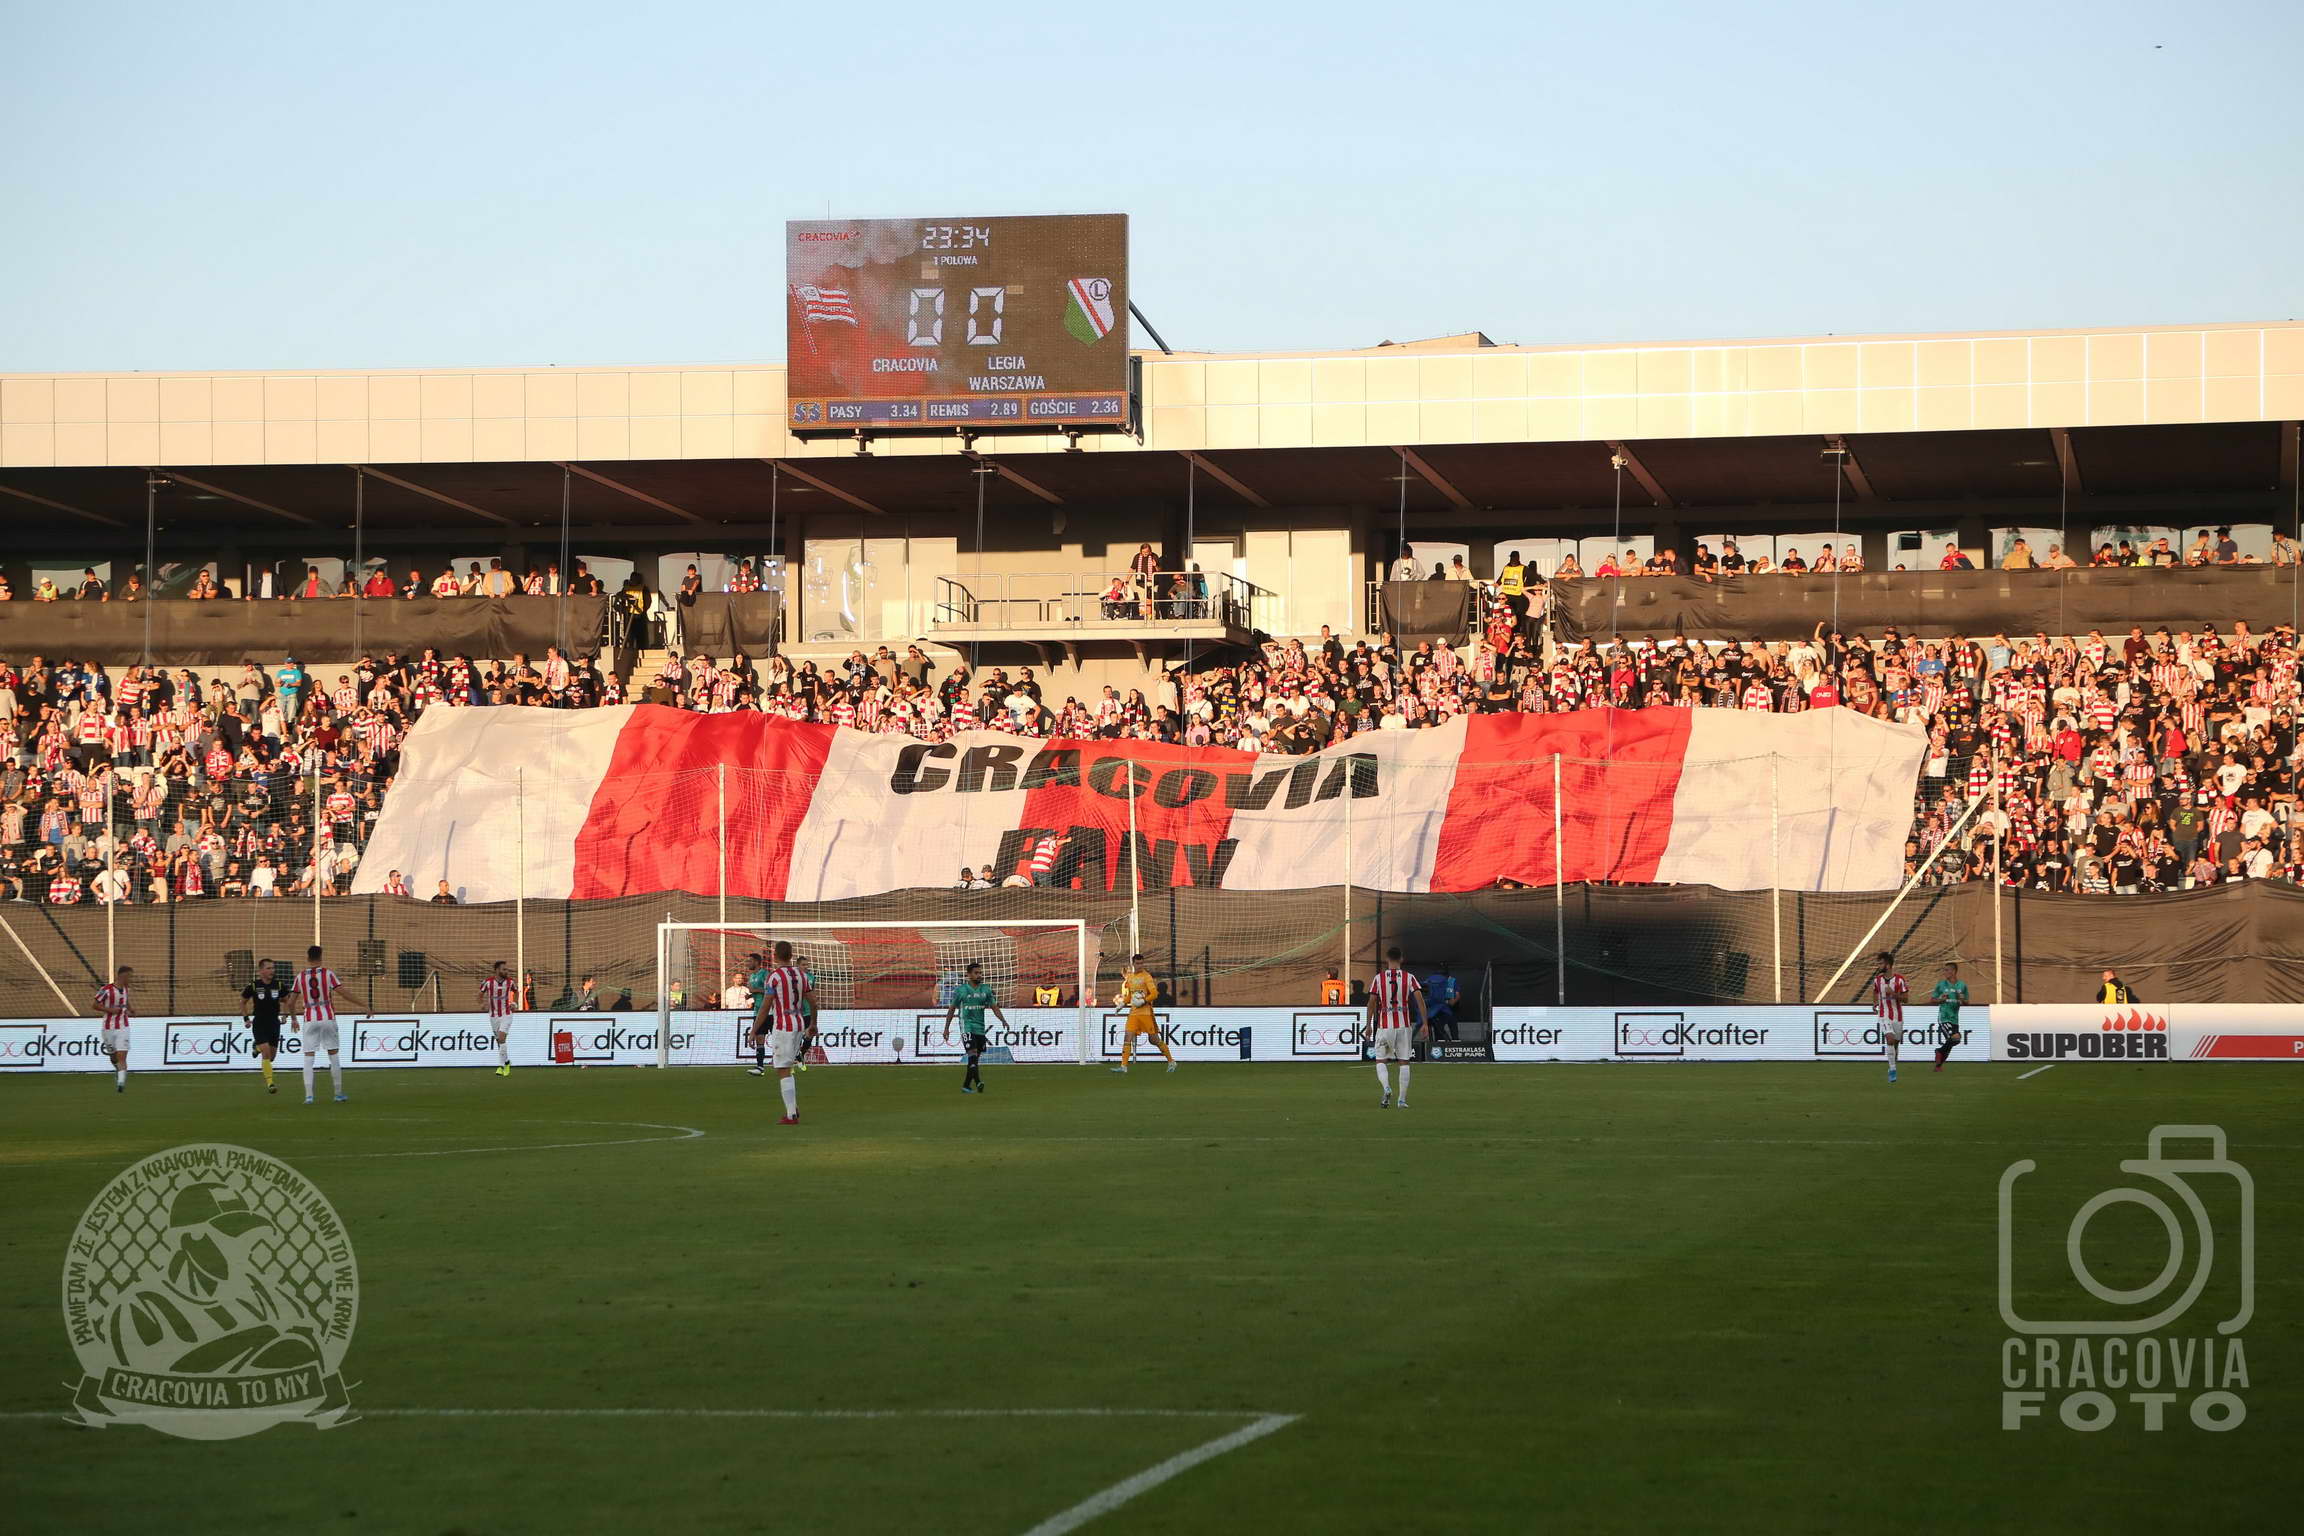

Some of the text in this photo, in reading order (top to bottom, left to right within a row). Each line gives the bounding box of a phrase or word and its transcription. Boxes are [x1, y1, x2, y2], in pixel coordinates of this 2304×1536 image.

[798, 232, 849, 242] CRACOVIA
[922, 226, 990, 249] 23:34
[907, 287, 945, 347] 0
[967, 286, 1005, 346] 0
[872, 358, 939, 373] CRACOVIA
[987, 356, 1026, 370] LEGIA
[968, 375, 1046, 391] WARSZAWA
[829, 404, 918, 419] PASY 3.34
[929, 402, 1018, 417] REMIS 2.89
[1030, 399, 1119, 415] GOŚCIE 2.36
[890, 742, 1380, 811] CRACOVIA
[1620, 1023, 1769, 1045] foodKrafter
[2006, 1033, 2168, 1058] SUPOBER
